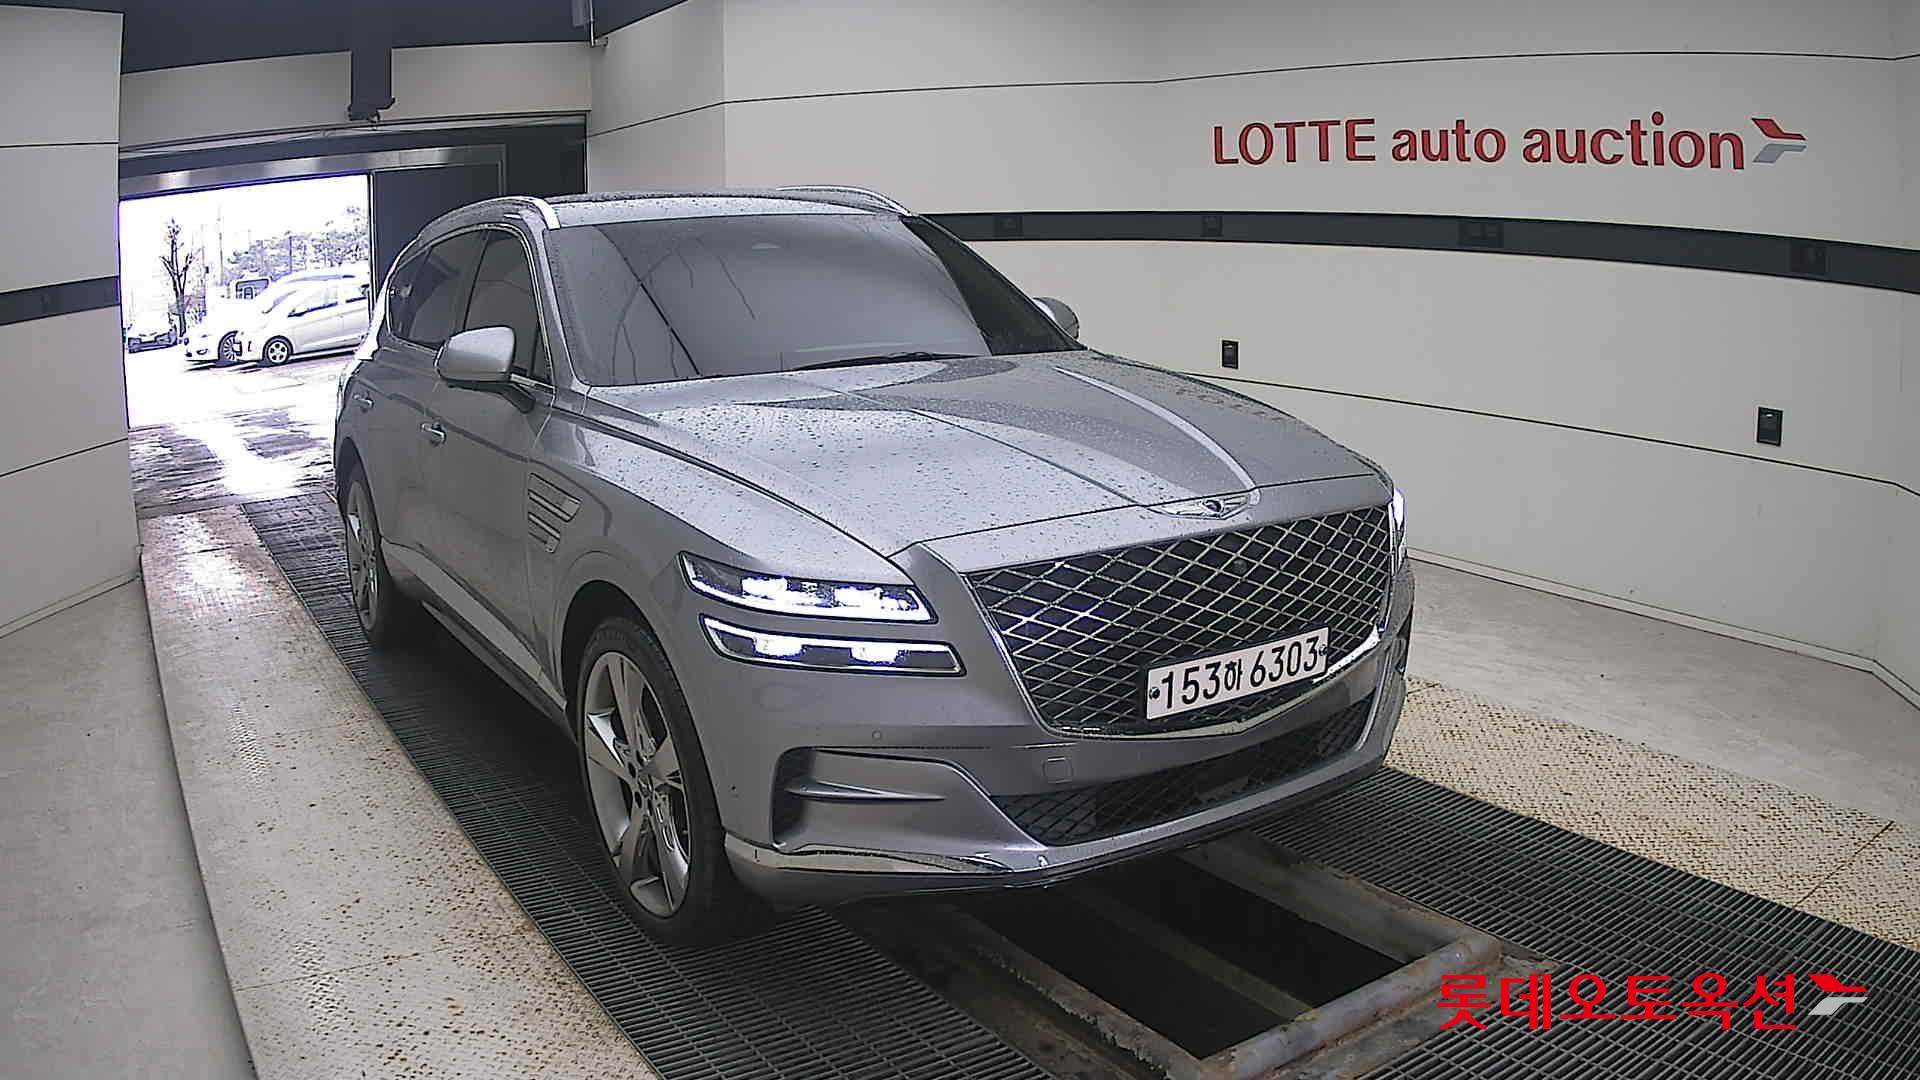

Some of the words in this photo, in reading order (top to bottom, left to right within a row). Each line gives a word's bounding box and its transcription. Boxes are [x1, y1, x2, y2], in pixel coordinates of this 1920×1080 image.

[1213, 118, 1376, 165] LOTTE
[1391, 118, 1506, 163] auto
[1522, 111, 1745, 170] auction
[1161, 658, 1243, 709] 153하
[1250, 636, 1320, 688] 6303
